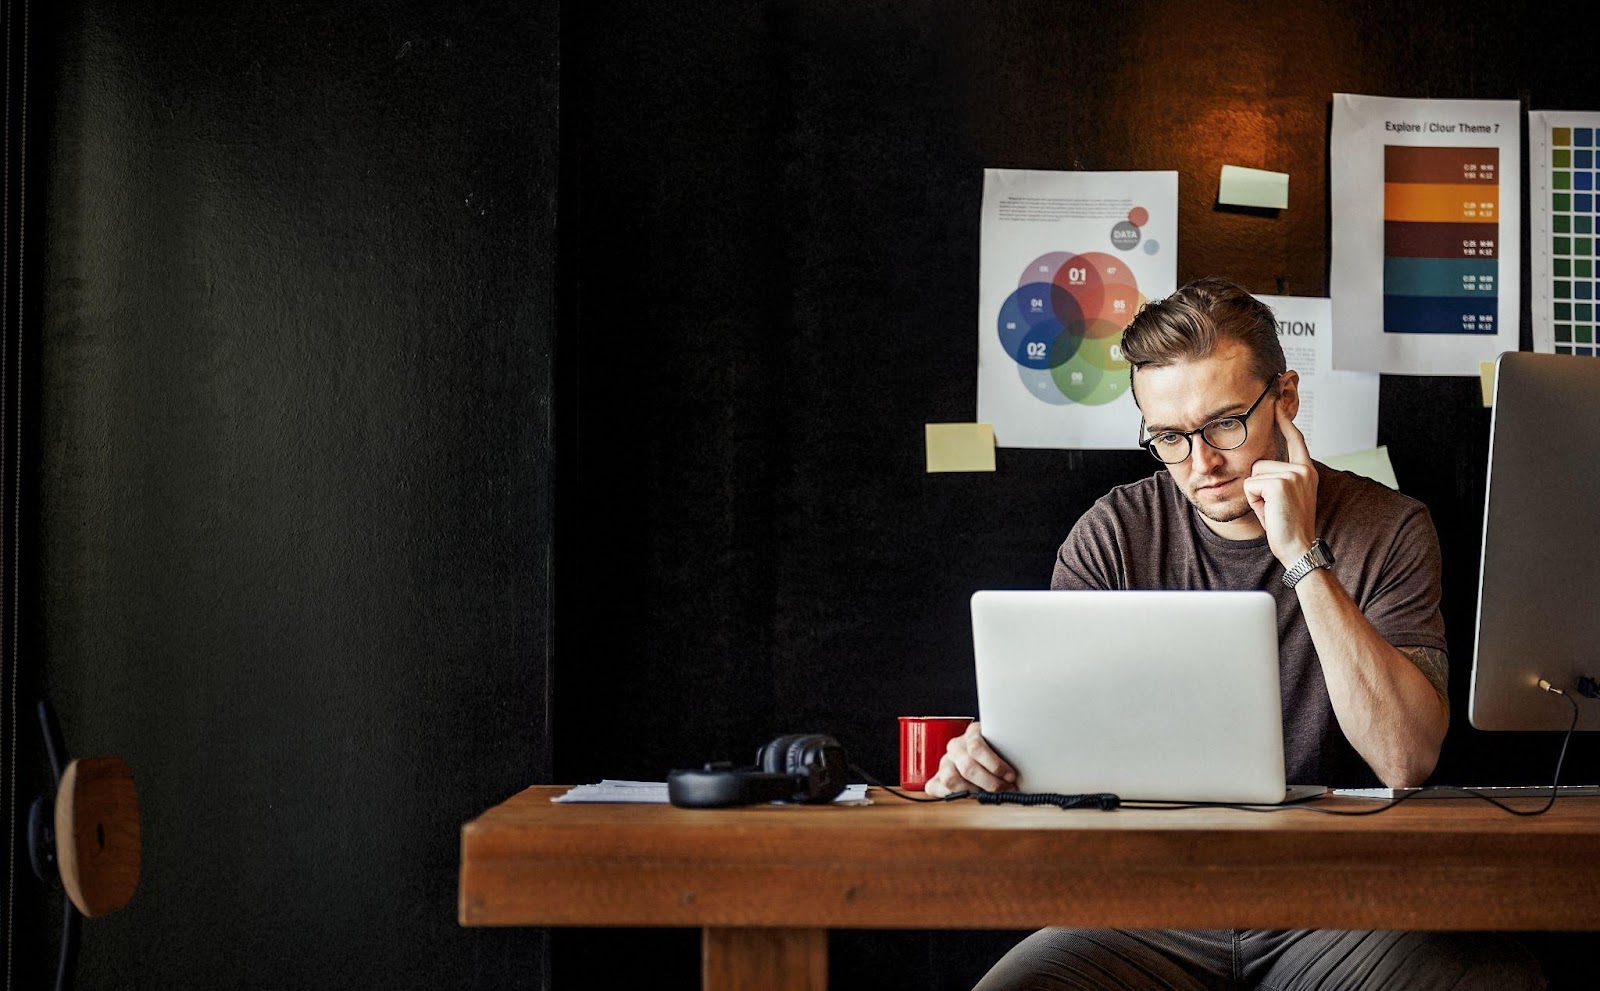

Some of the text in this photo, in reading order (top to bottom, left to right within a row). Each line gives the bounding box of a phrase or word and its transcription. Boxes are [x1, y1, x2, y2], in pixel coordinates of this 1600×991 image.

[1385, 121, 1421, 133] Explore
[1459, 123, 1492, 133] Theme
[1494, 123, 1500, 133] 7
[1113, 229, 1138, 239] DATA
[1069, 267, 1086, 281] 01
[1031, 299, 1043, 308] 04
[1027, 342, 1046, 357] 02
